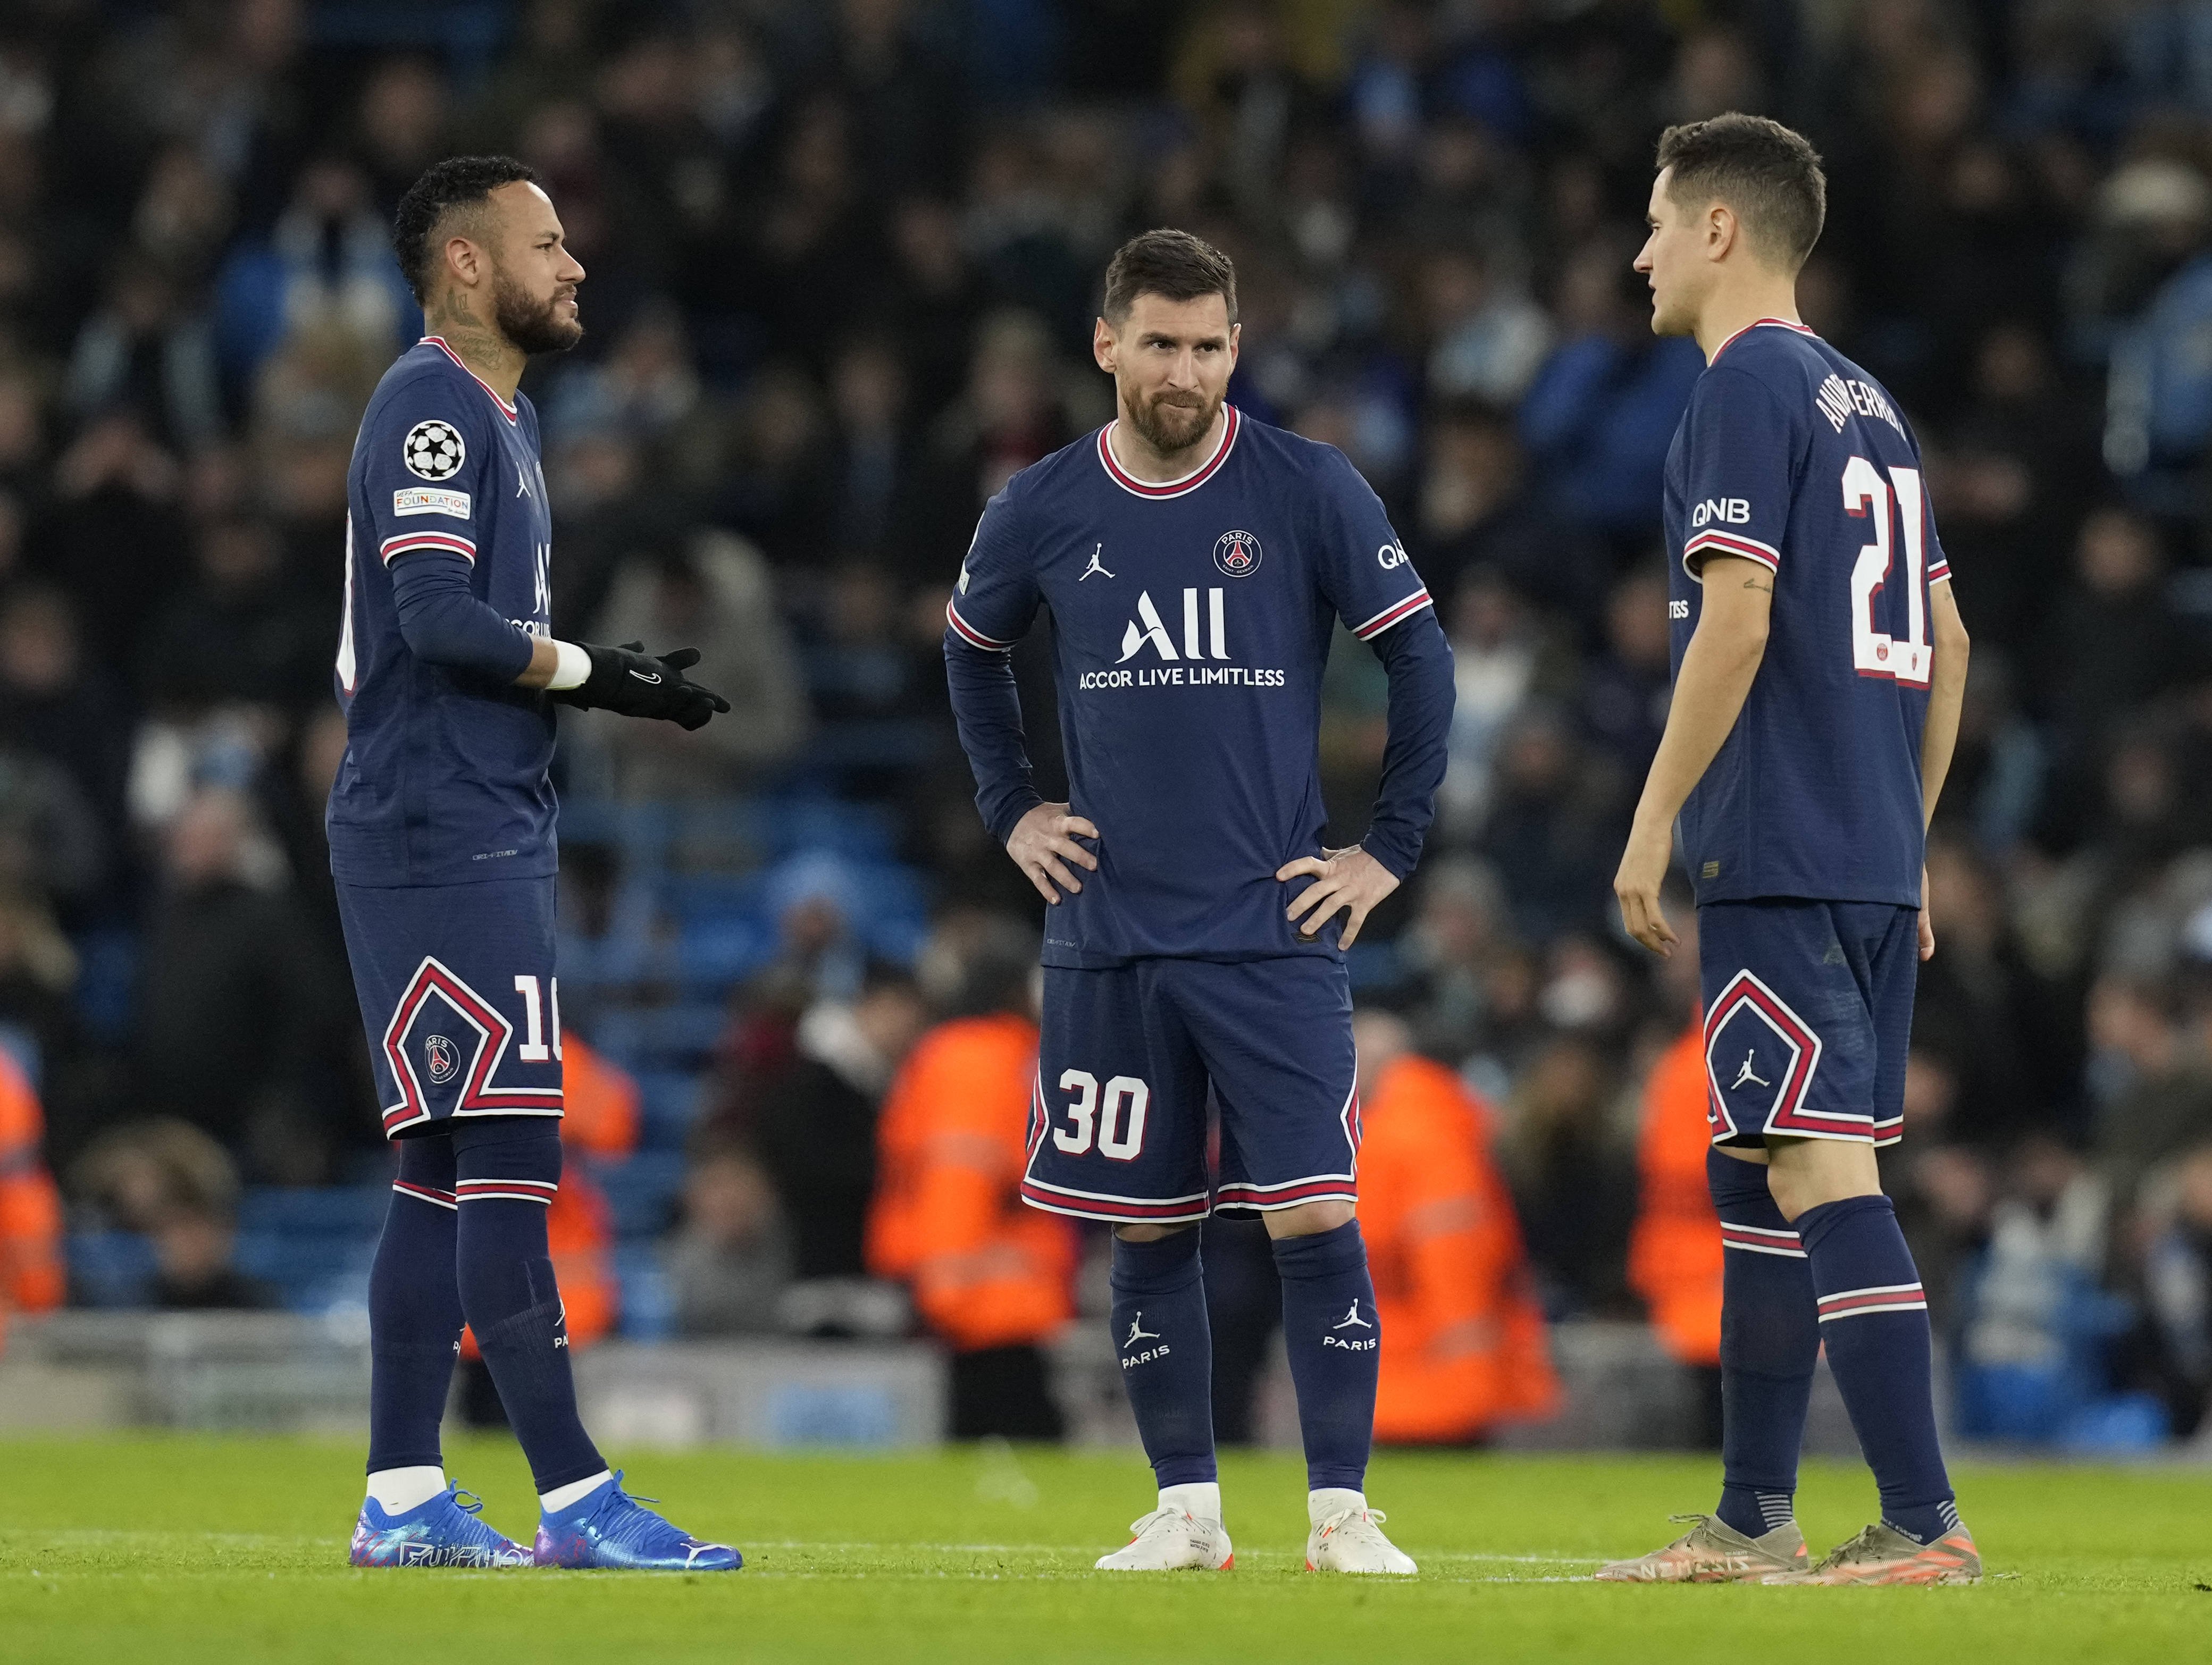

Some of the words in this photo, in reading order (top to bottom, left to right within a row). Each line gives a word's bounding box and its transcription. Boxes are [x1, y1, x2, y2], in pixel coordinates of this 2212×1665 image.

[396, 495, 468, 509] FOUNDATION
[1692, 498, 1750, 527] QNB
[1221, 533, 1253, 545] PARIS
[1378, 538, 1409, 569] QN
[1842, 456, 1933, 689] 21
[1079, 670, 1133, 689] ACCOR
[1139, 668, 1184, 686] LIVE
[1189, 668, 1285, 687] LIMITLESS
[426, 1037, 448, 1050] PARIS
[1053, 1068, 1150, 1162] 30
[1323, 1336, 1376, 1350] PARIS
[1122, 1345, 1170, 1369] PARIS
